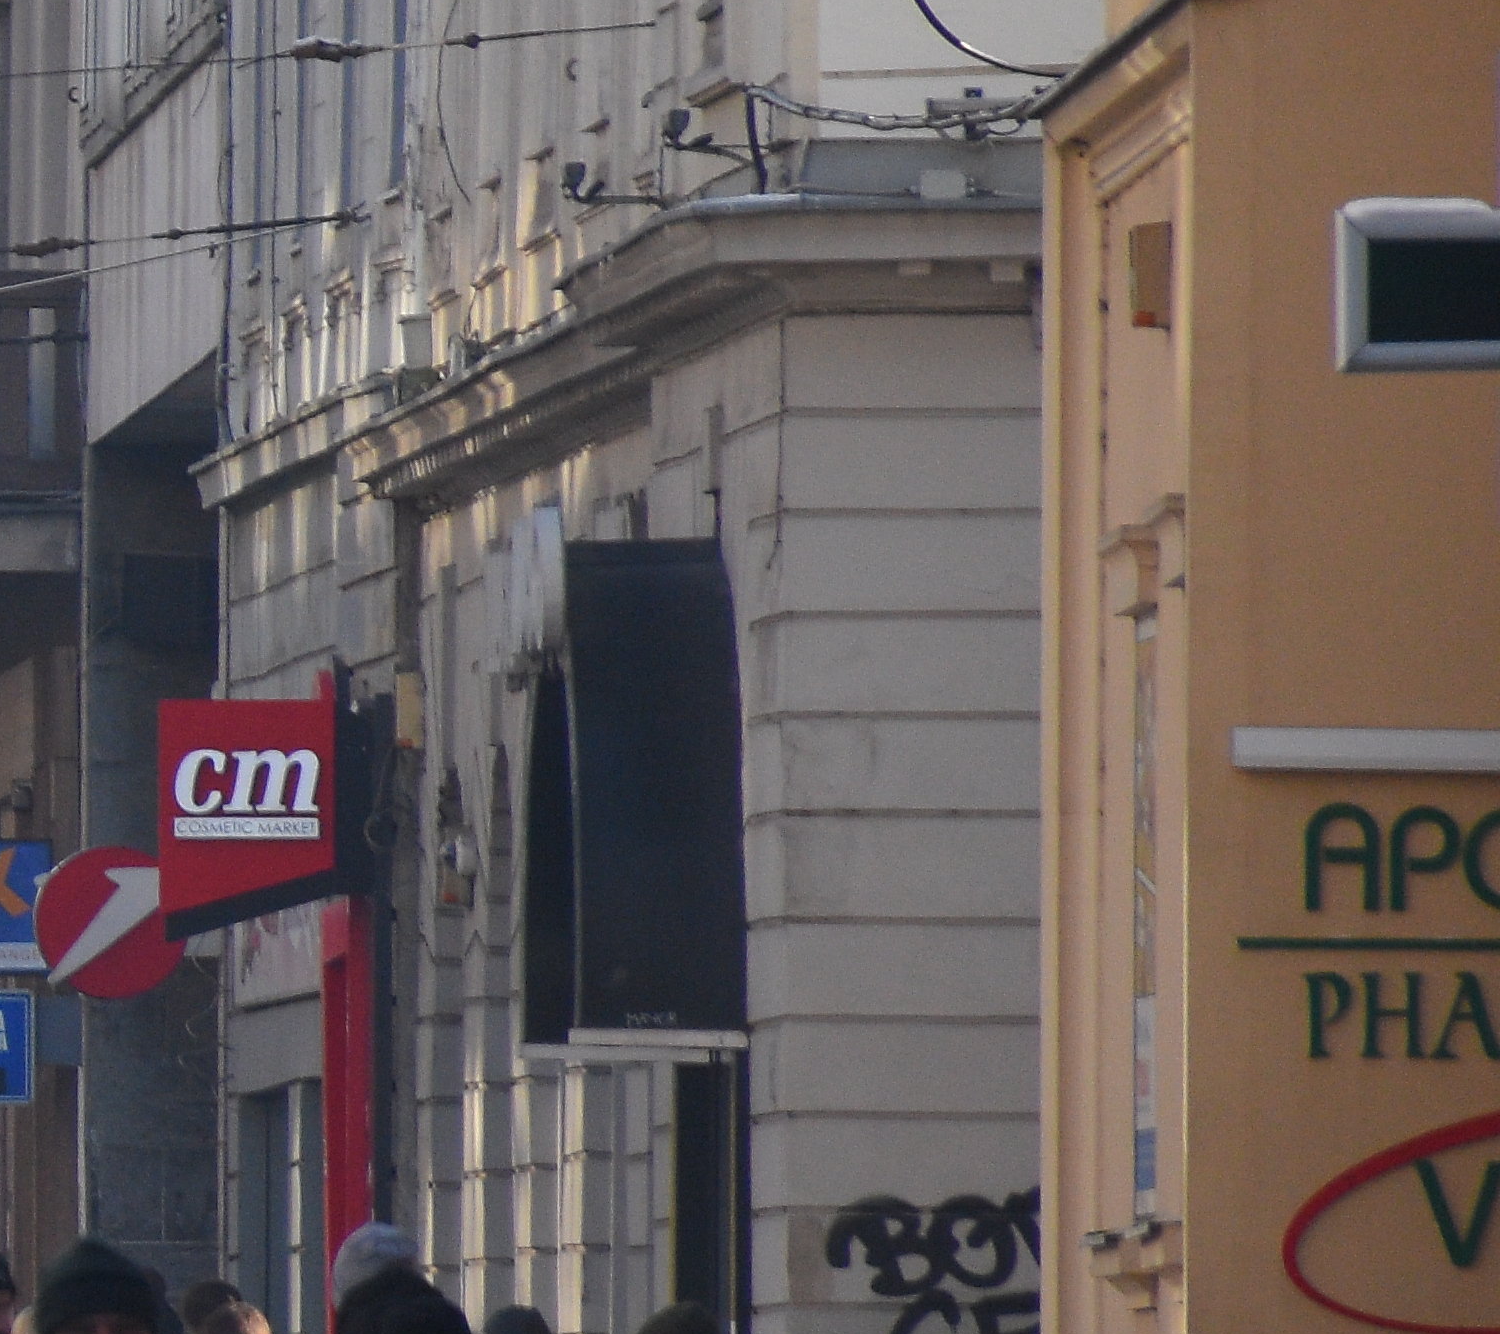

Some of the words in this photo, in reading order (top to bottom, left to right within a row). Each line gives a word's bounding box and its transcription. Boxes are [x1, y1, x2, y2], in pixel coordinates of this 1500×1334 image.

[173, 748, 321, 815] cm
[176, 820, 253, 835] COSMETIC
[257, 820, 316, 834] MARKET
